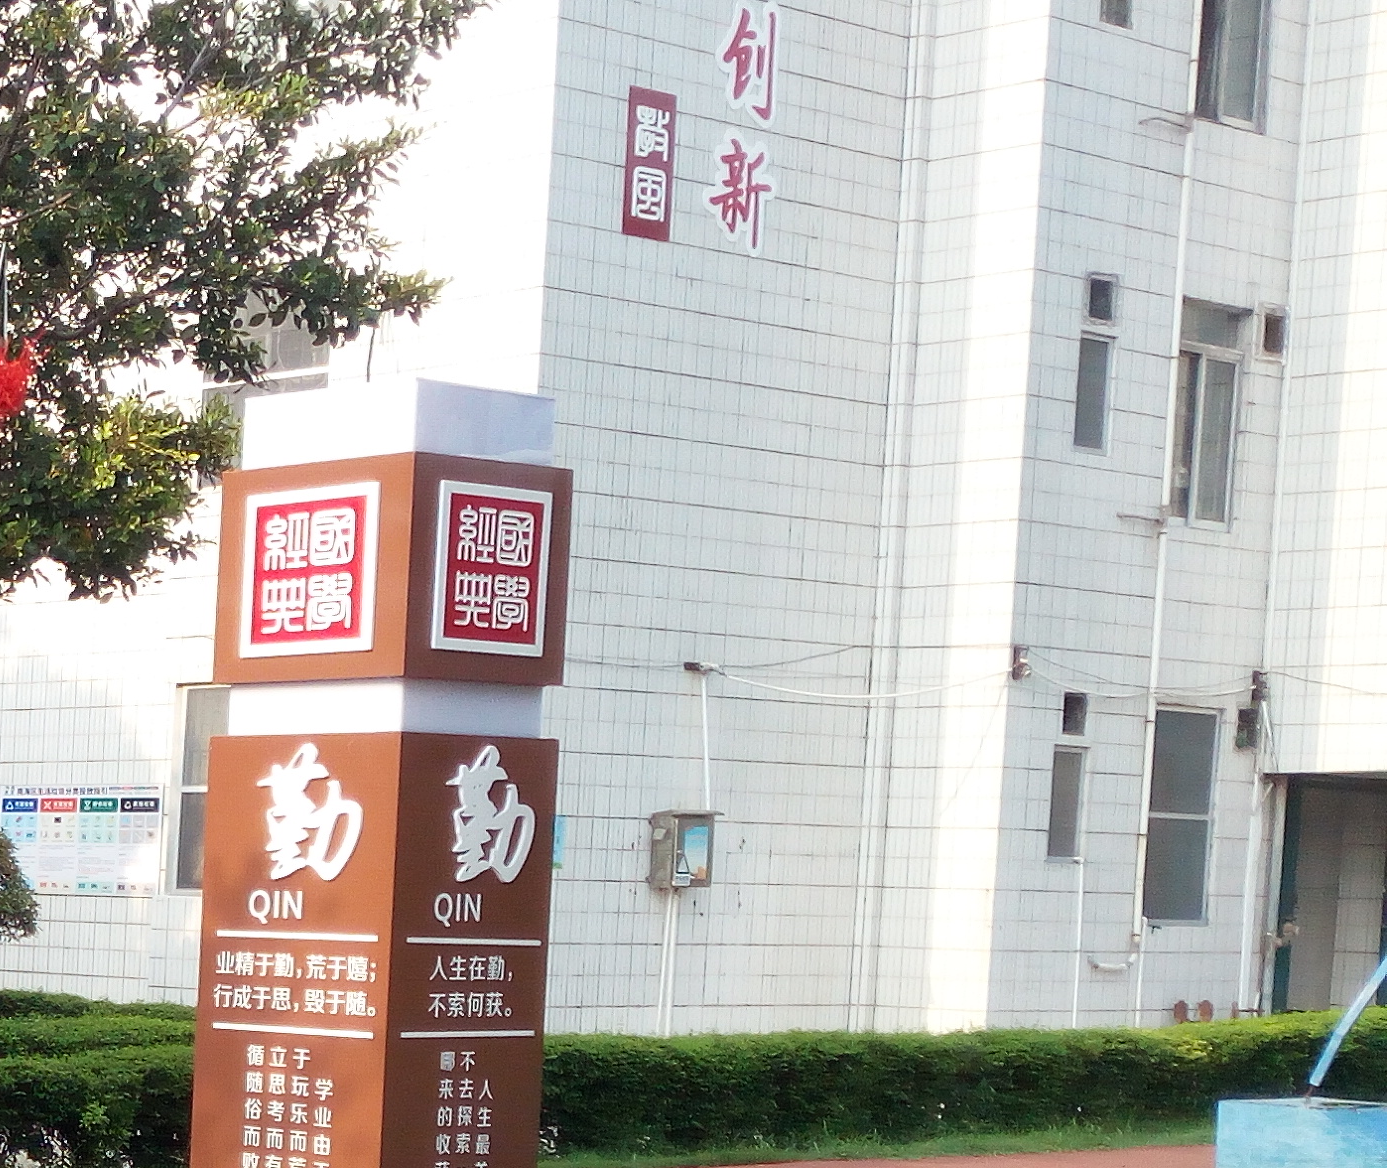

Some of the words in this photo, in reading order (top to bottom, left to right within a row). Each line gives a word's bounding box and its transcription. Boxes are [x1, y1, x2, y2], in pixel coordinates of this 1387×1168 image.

[708, 7, 777, 249] 创新
[256, 742, 364, 881] 勤
[445, 745, 537, 883] 勤
[248, 890, 303, 925] QIN
[433, 893, 482, 927] QIN
[429, 955, 513, 982] 人生在勤，
[213, 983, 377, 1017] 行成于思，毁于随。
[428, 991, 512, 1018] 不索何获。
